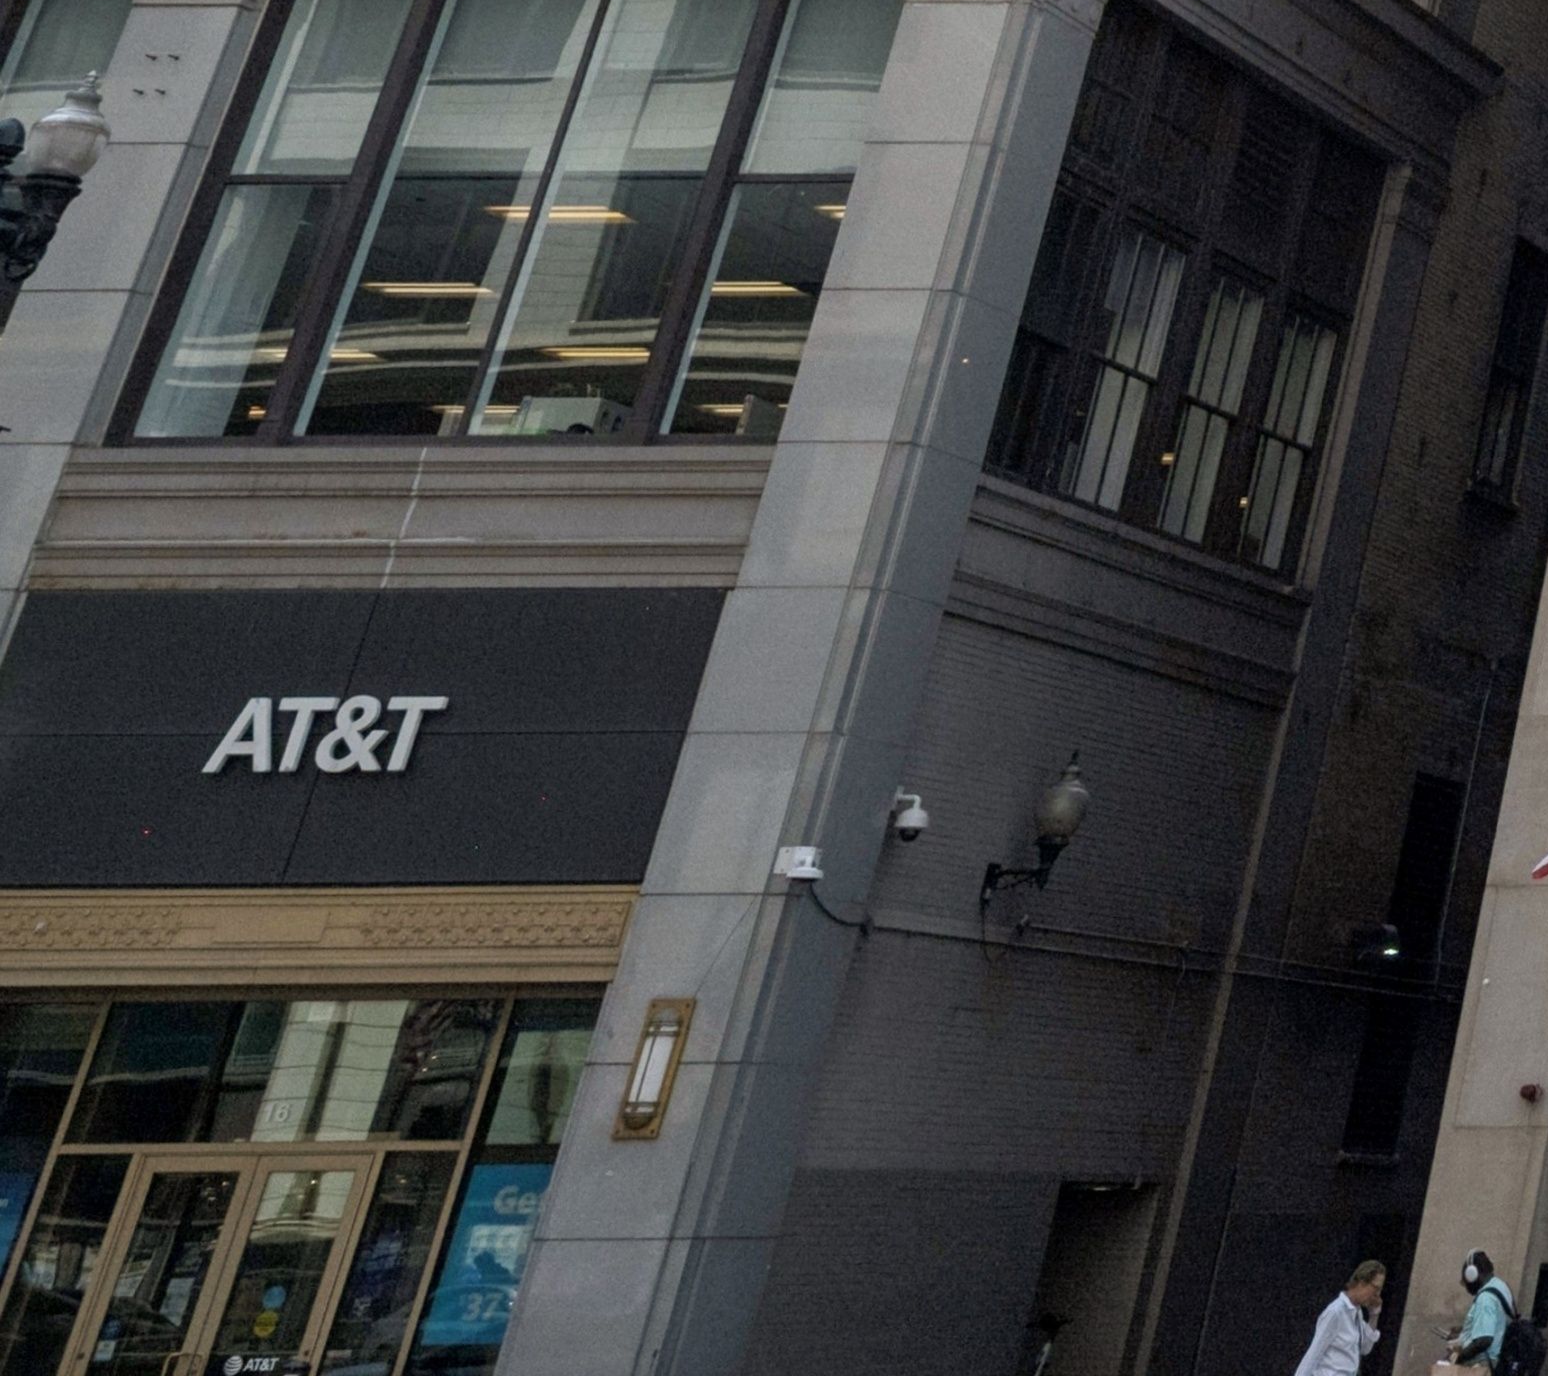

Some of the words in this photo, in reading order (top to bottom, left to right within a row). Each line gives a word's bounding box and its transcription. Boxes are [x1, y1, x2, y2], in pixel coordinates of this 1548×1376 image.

[203, 695, 449, 773] AT&T
[493, 1184, 547, 1216] Ge
[243, 1357, 280, 1371] AT&T
